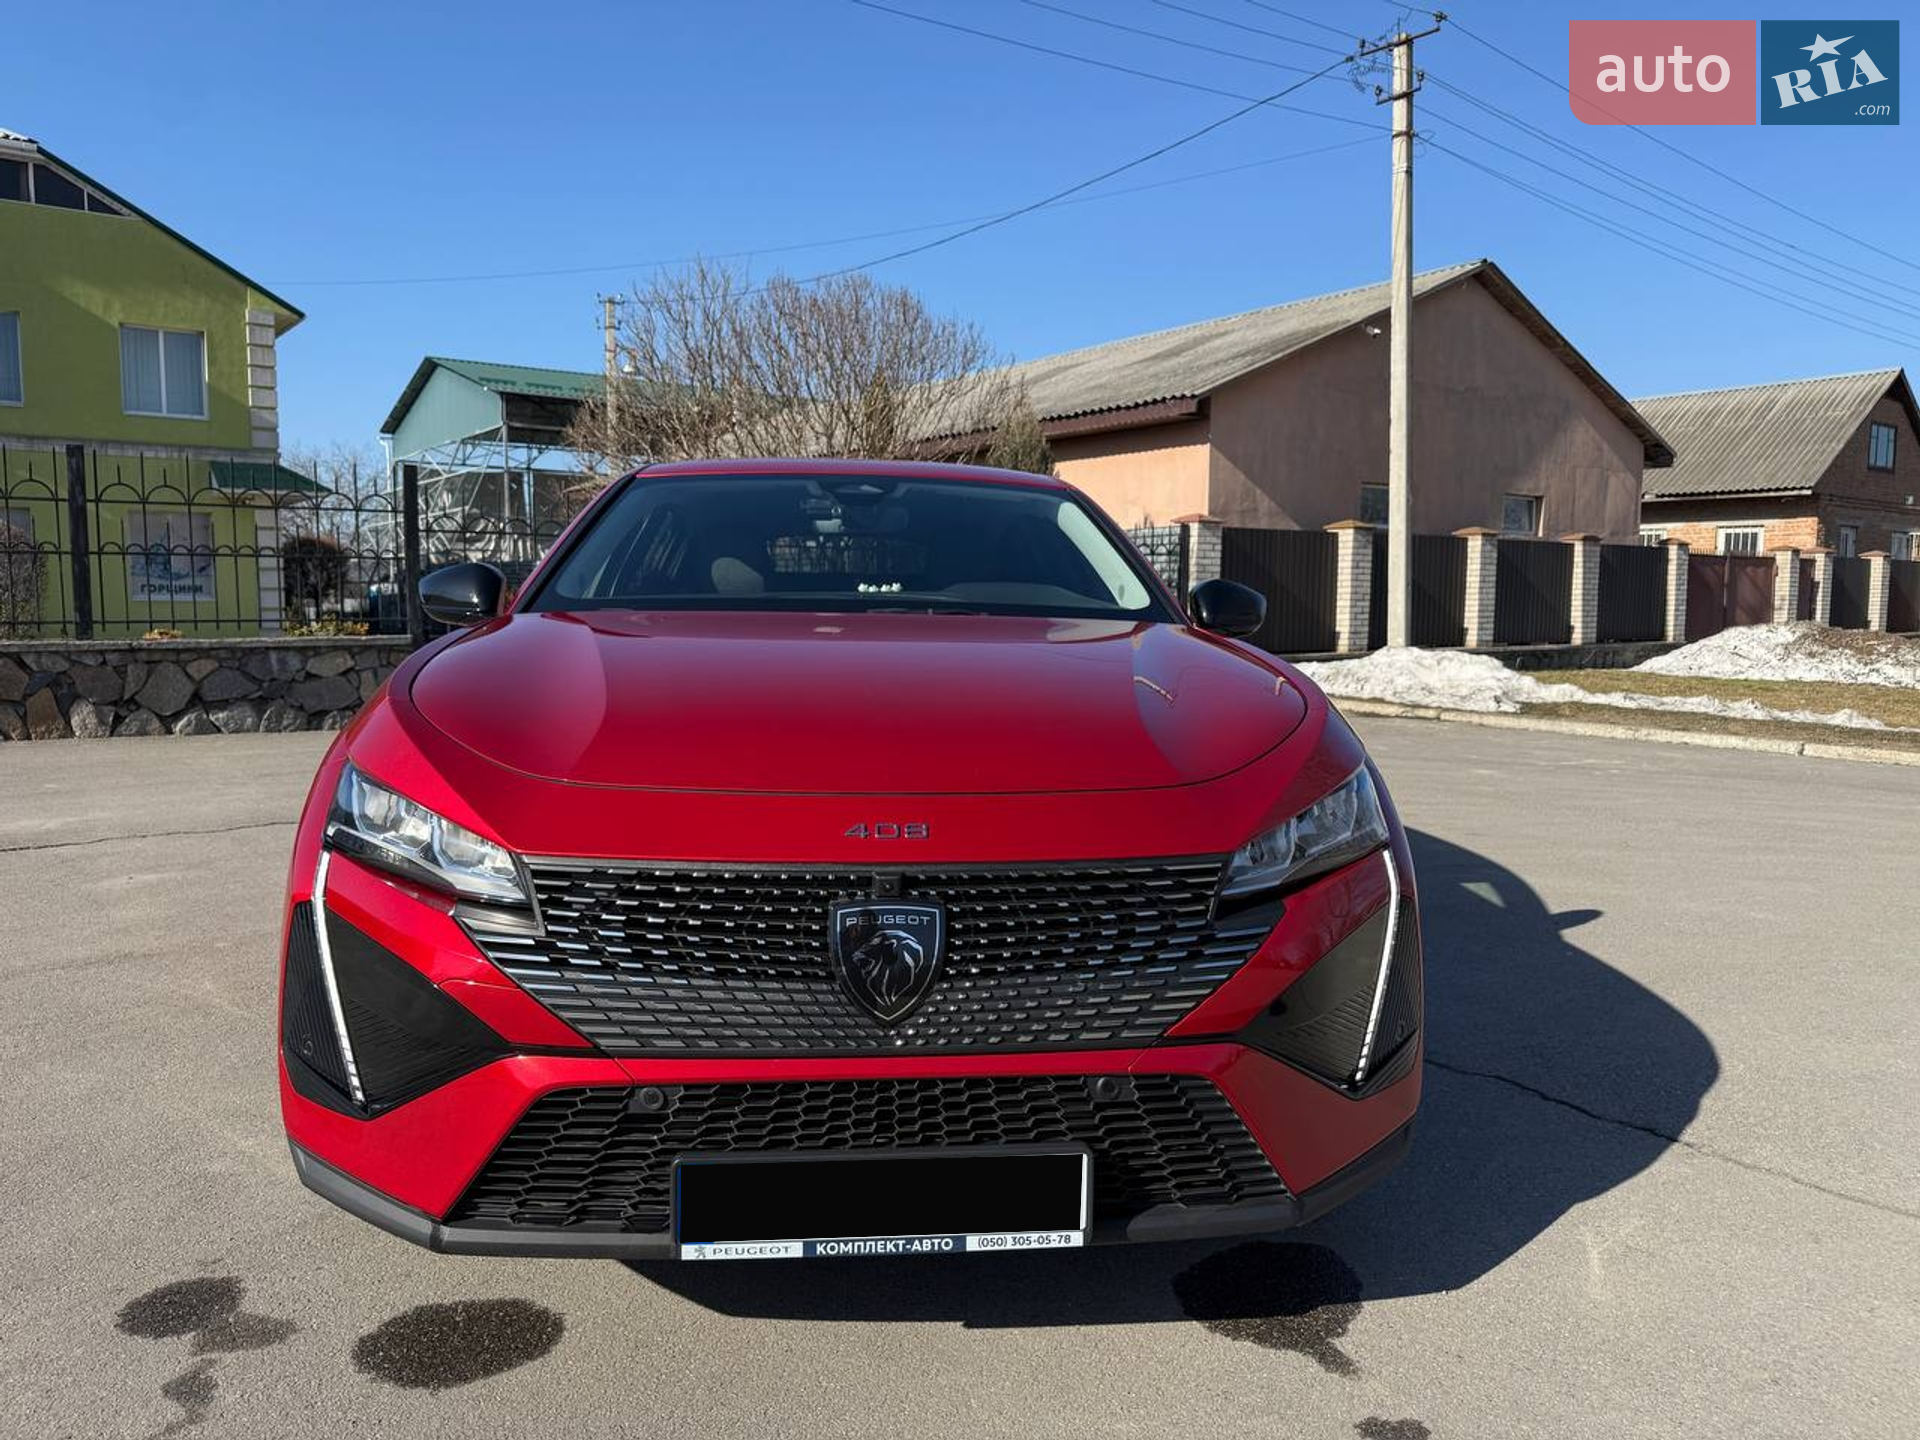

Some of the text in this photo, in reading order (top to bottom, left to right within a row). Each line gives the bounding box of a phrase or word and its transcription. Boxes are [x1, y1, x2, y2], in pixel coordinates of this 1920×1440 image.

[844, 823, 930, 839] 408
[846, 914, 931, 927] PEUGEOT
[815, 1238, 954, 1256] КОМПЛЕКТ-АВТО
[977, 1234, 1072, 1248] (050) 305-05-78
[712, 1245, 792, 1257] PEUGEOT
